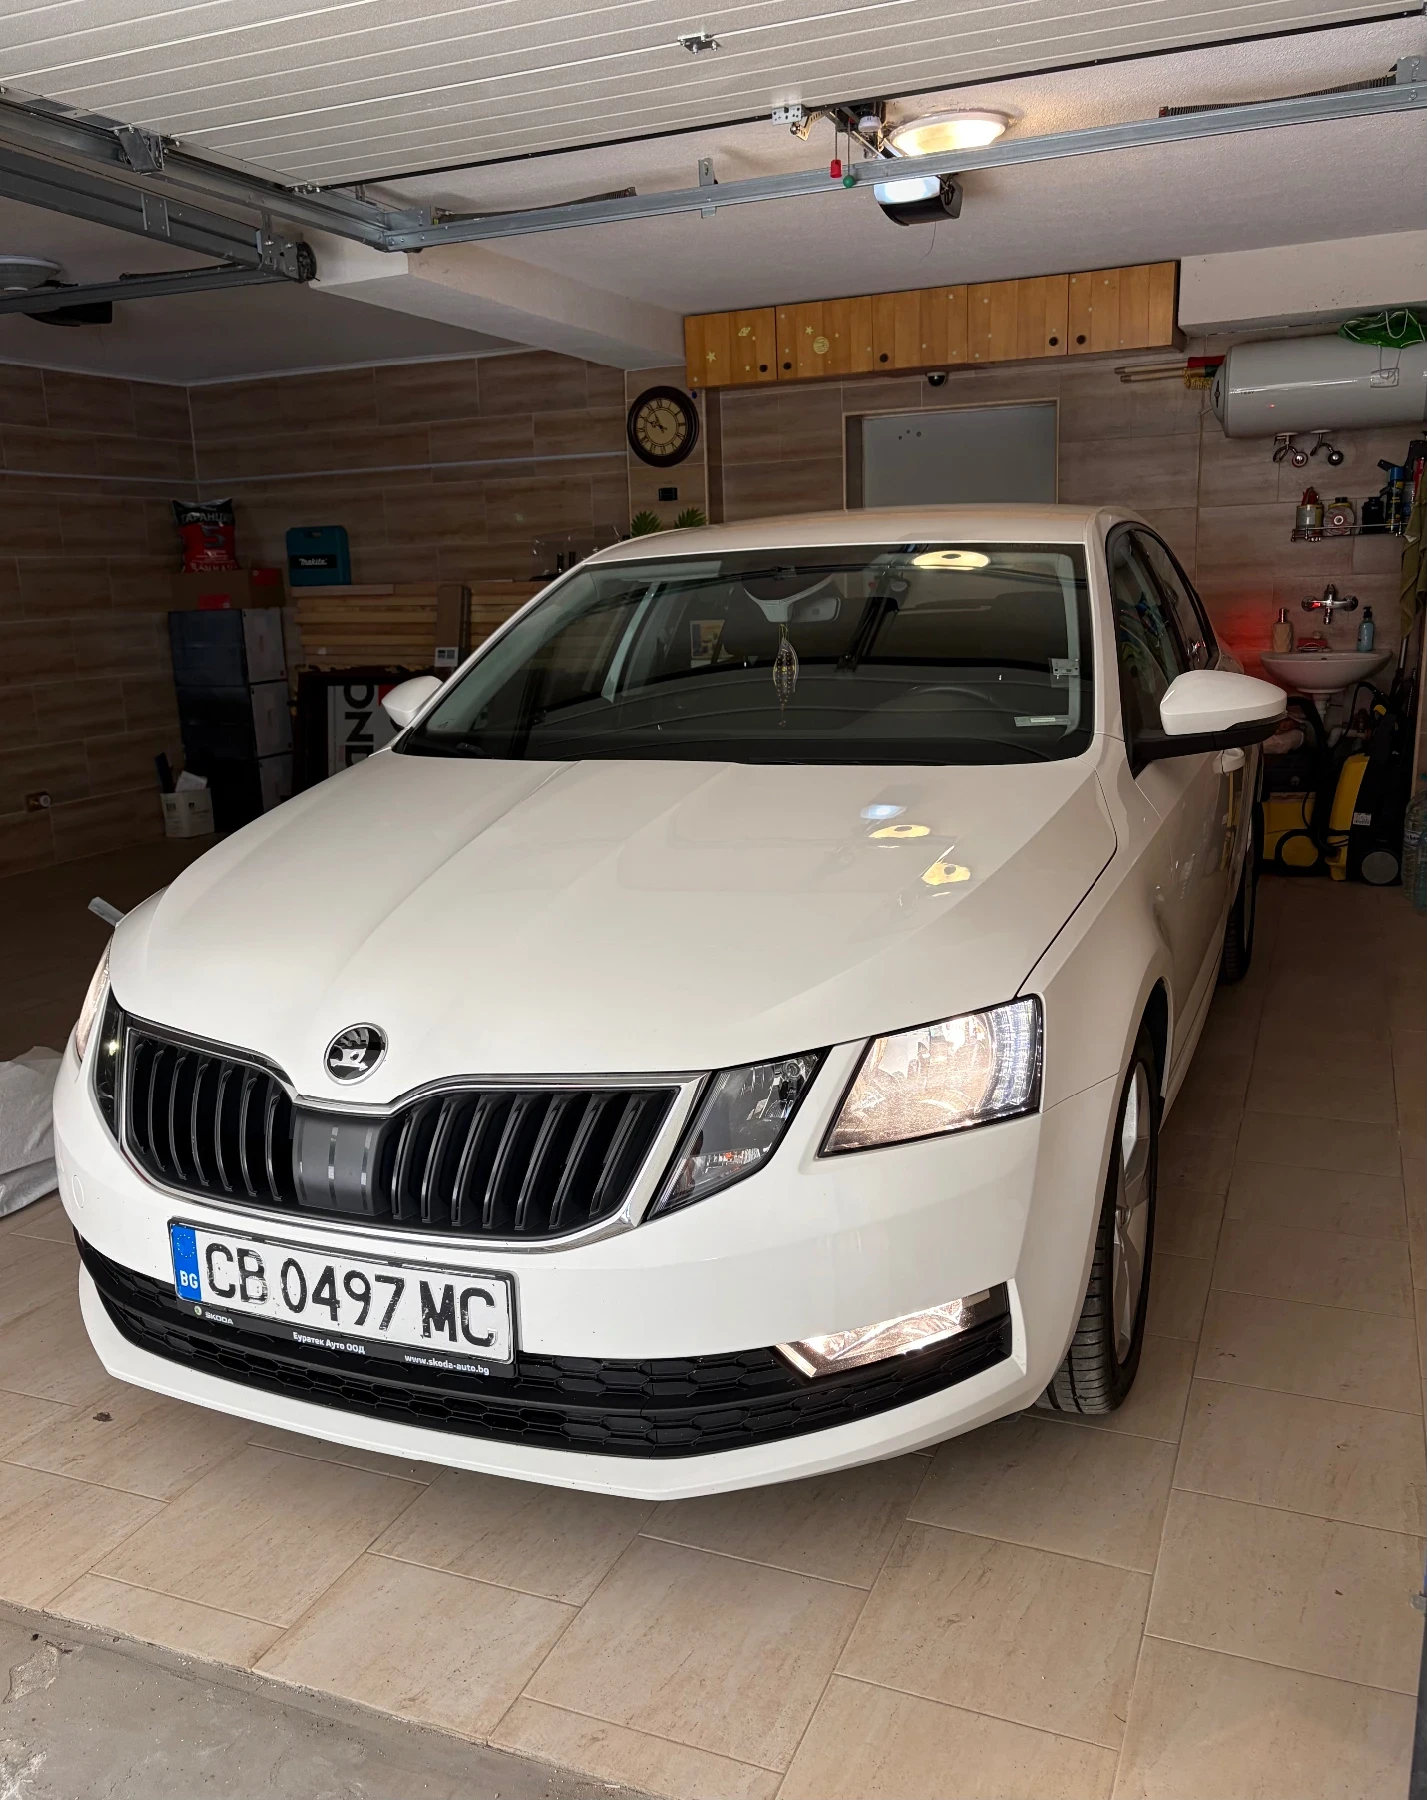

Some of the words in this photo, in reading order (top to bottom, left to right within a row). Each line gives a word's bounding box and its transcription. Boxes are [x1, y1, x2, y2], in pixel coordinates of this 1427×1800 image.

[180, 1269, 199, 1289] BG
[205, 1242, 269, 1304] CB
[280, 1257, 405, 1332] 0497
[418, 1279, 497, 1348] MC
[325, 1338, 345, 1350] Ауто
[346, 1342, 366, 1355] ООД
[404, 1354, 490, 1376] www.skoda-auto.bg
